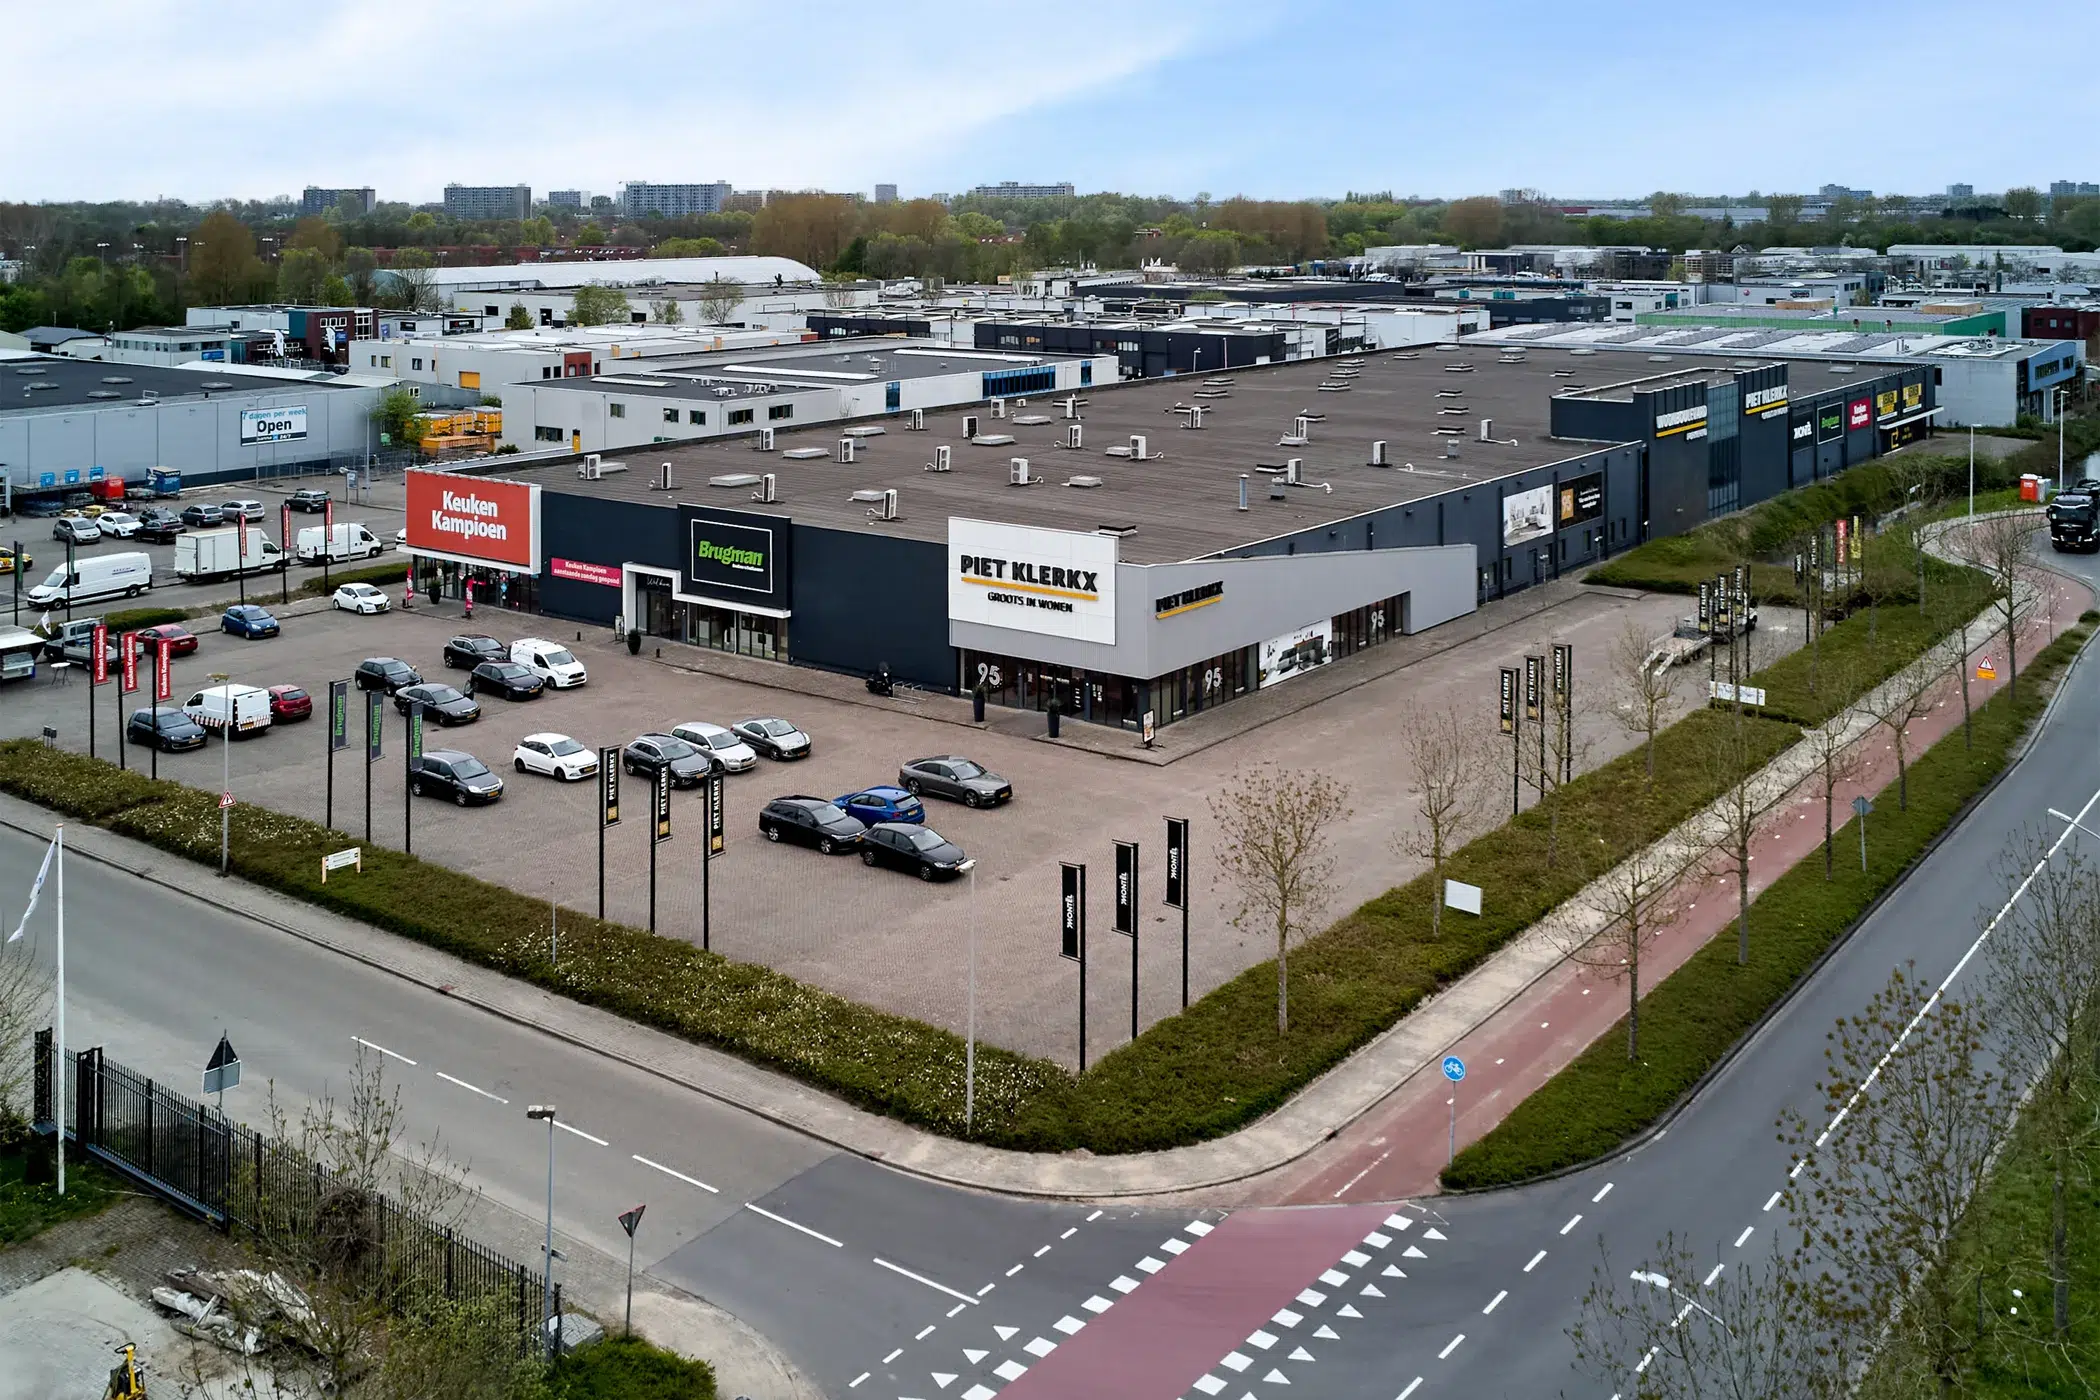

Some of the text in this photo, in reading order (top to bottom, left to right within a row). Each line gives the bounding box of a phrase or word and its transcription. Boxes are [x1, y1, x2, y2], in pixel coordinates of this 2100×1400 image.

[249, 412, 272, 420] dagen
[274, 410, 286, 418] per
[257, 420, 292, 434] Open
[442, 490, 498, 517] Keuken
[432, 510, 507, 540] Kampioen
[699, 540, 764, 565] Brugman
[961, 555, 1097, 592] PIET KLERKX
[988, 592, 1073, 612] GROOTS IN WONEN
[1371, 610, 1385, 634] 95
[977, 662, 1000, 686] 95
[1205, 667, 1222, 693] 95
[335, 695, 344, 736] Brugman
[372, 704, 381, 747] Brugman
[413, 715, 421, 757] Brugman
